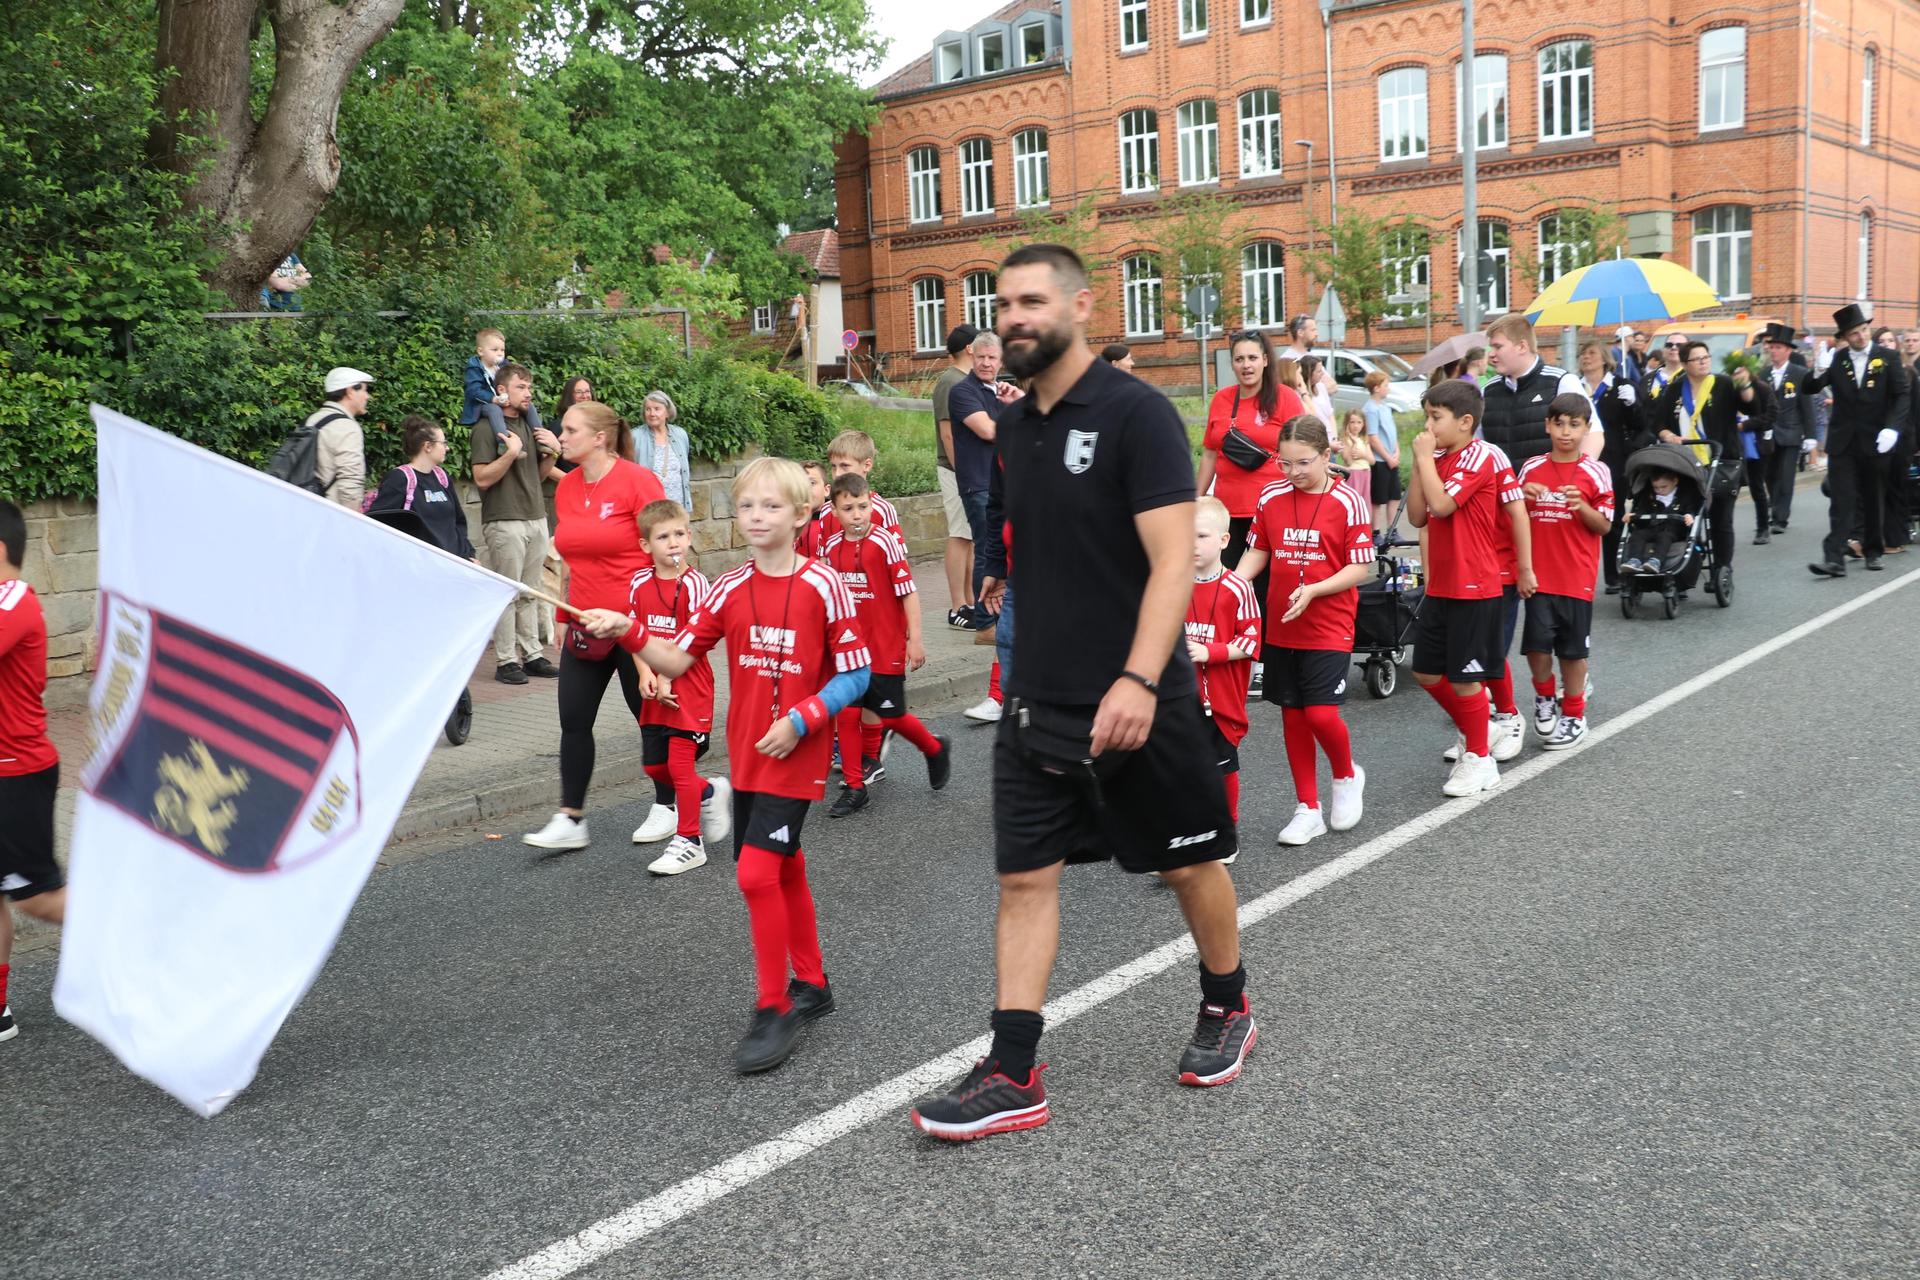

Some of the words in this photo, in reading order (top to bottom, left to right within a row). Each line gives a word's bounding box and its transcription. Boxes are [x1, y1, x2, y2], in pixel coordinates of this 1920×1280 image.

[1283, 527, 1308, 541] LVM
[1275, 549, 1292, 560] Björn
[1294, 551, 1326, 561] Weidlich
[750, 625, 782, 645] LVM
